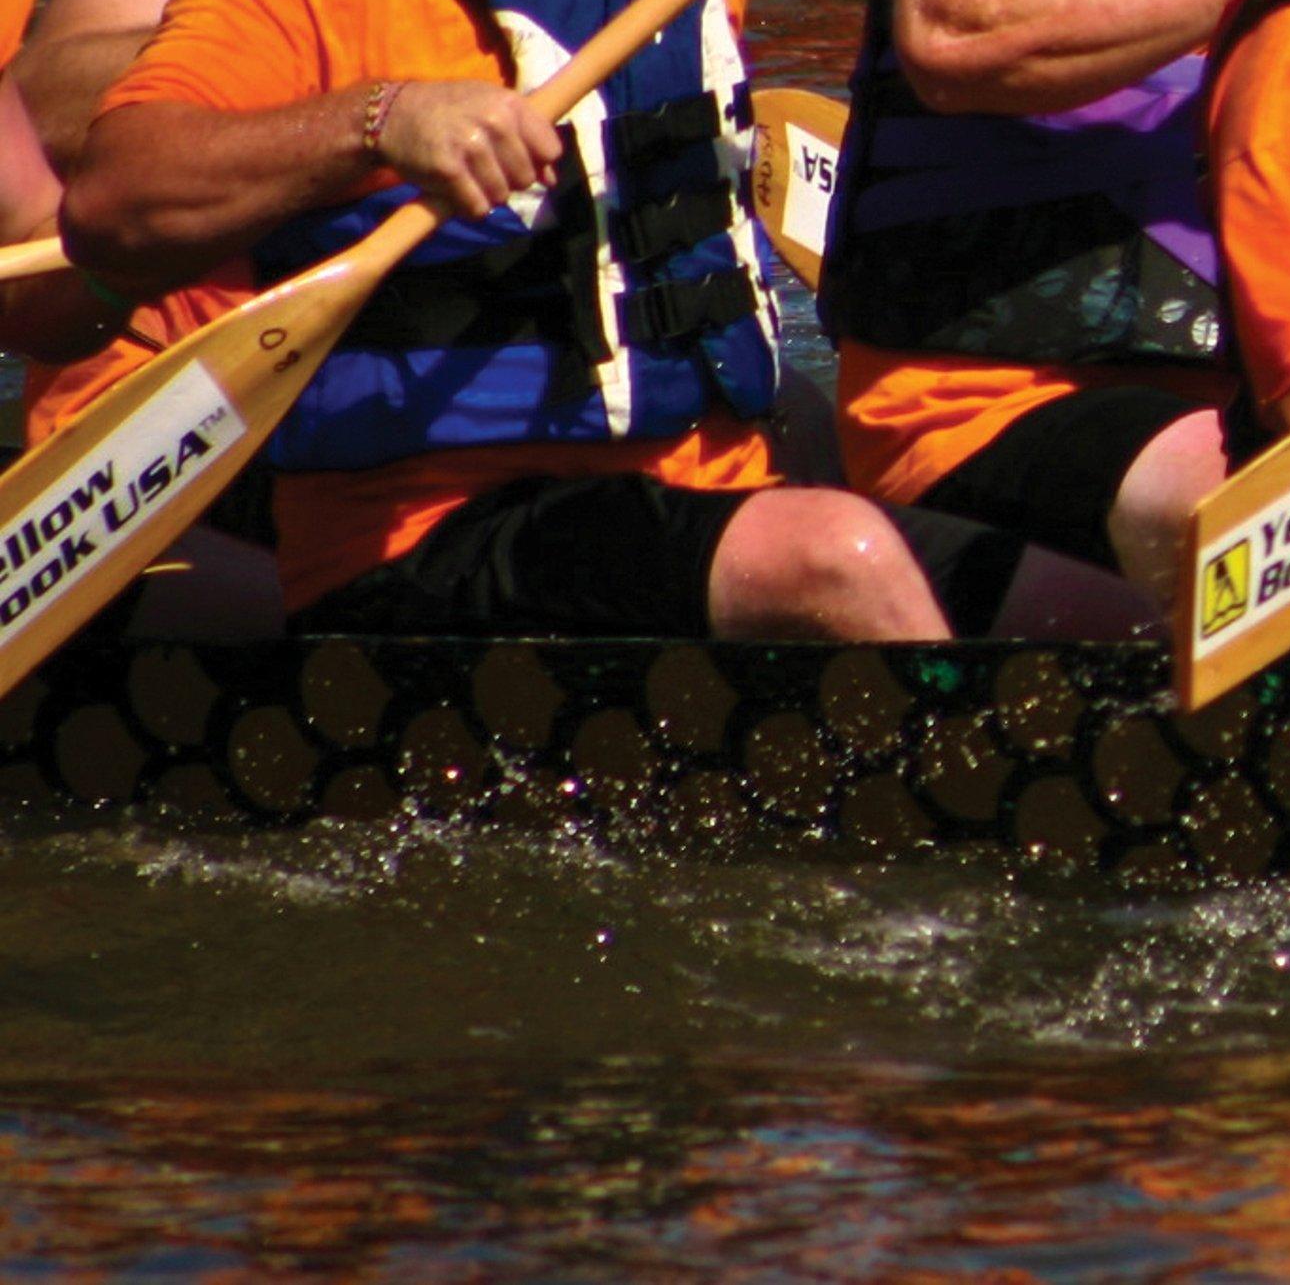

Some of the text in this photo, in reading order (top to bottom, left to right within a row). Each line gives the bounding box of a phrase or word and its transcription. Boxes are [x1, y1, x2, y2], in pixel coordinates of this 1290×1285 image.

[802, 145, 833, 195] SA
[0, 460, 115, 583] llow
[0, 530, 97, 627] ook
